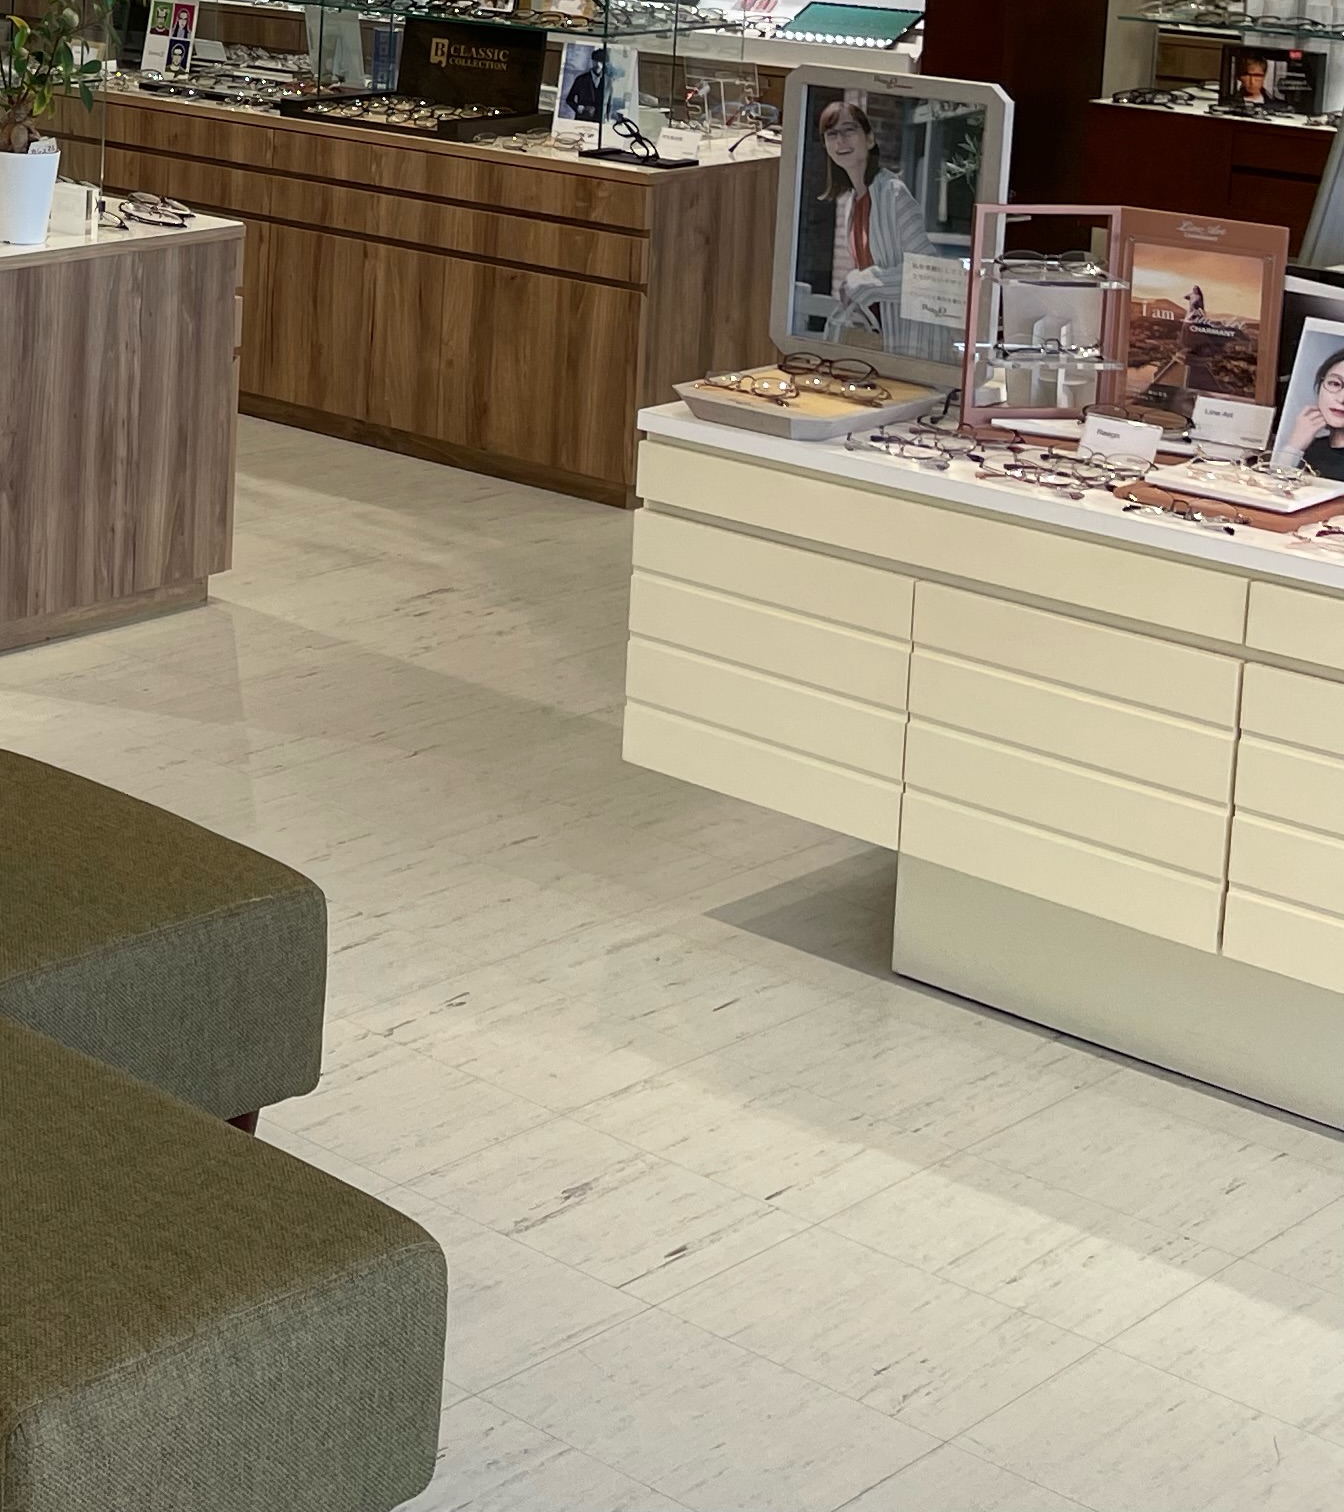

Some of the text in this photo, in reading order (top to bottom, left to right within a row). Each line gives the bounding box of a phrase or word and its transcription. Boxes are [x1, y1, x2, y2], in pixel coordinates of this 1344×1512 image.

[450, 44, 510, 62] CLASSIC
[448, 56, 508, 71] COLLECTION
[1151, 308, 1176, 321] am
[1189, 324, 1237, 338] CHARMANT
